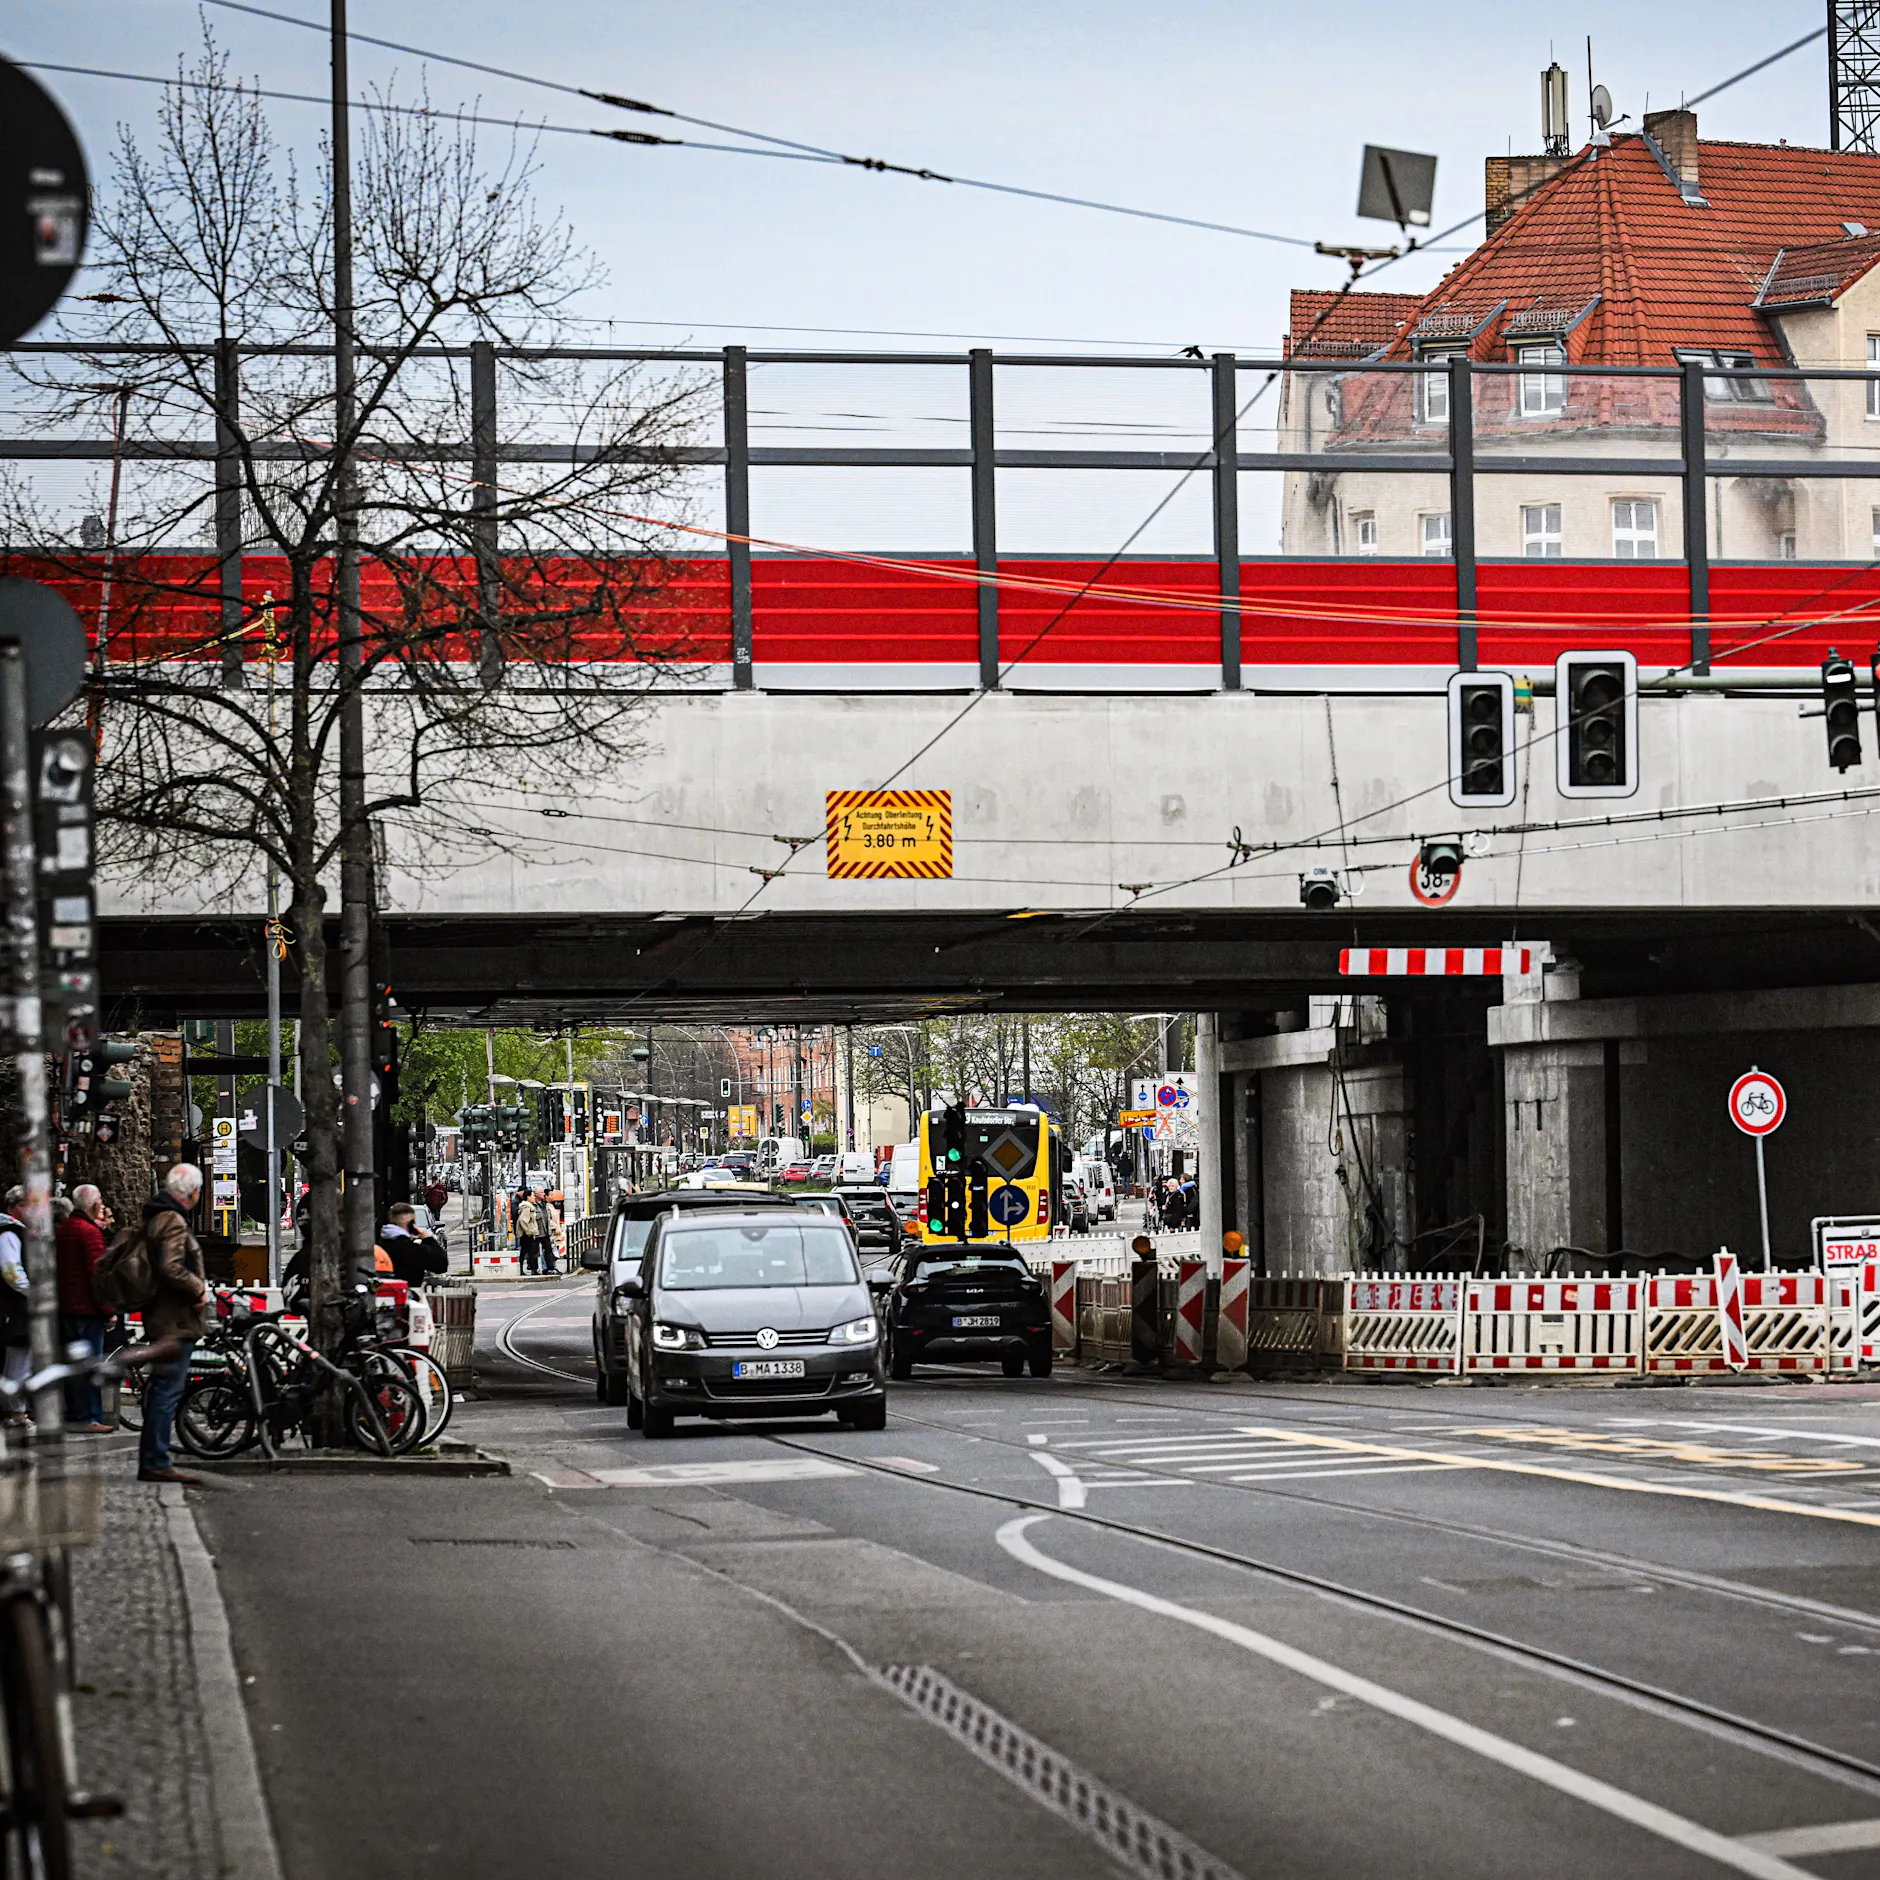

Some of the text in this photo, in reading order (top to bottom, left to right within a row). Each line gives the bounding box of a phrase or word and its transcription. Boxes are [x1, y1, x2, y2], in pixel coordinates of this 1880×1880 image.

[856, 811, 882, 820] Achtung
[862, 822, 916, 831] Durchfahrtshöhe
[863, 834, 916, 848] 3.80 m
[971, 1115, 1003, 1124] Kaulsdorfer
[1003, 1116, 1014, 1125] Str.
[740, 1362, 802, 1375] B MA 1338
